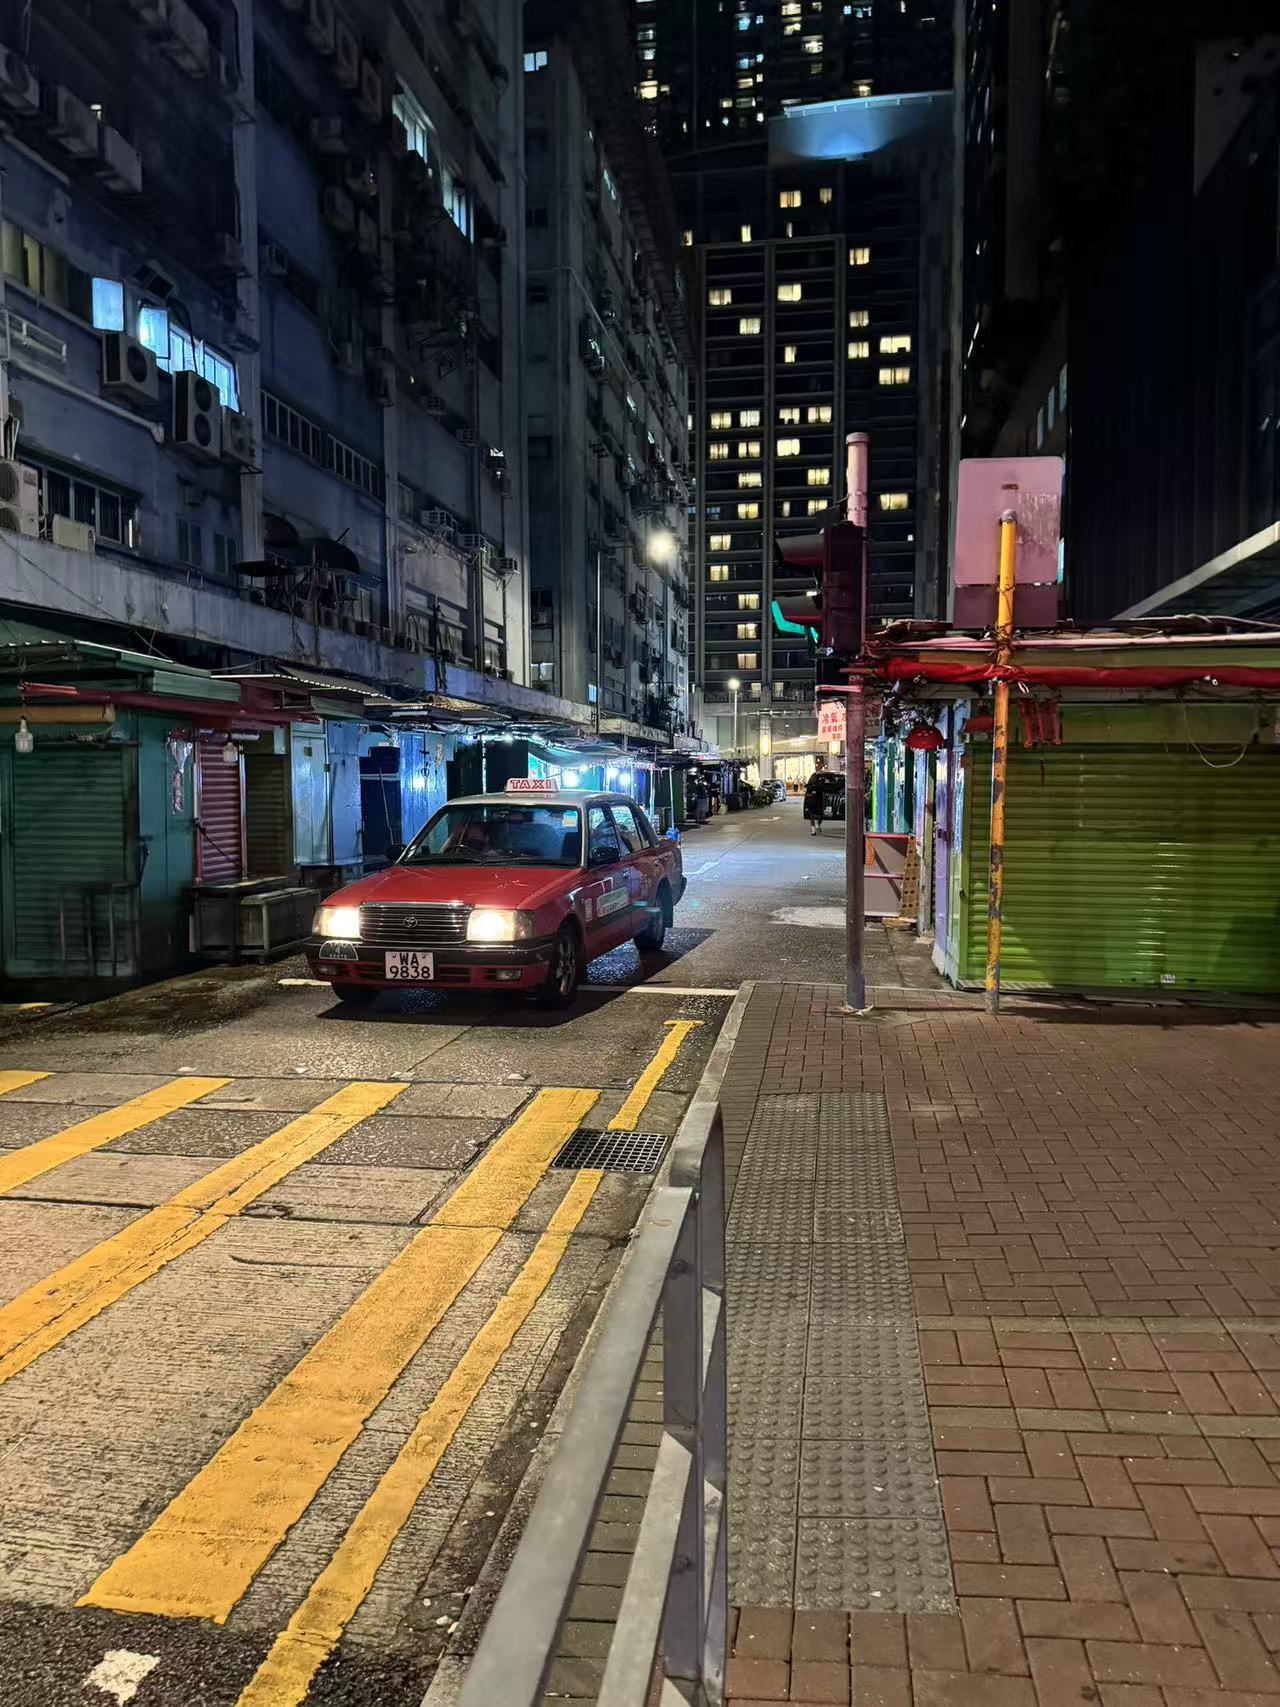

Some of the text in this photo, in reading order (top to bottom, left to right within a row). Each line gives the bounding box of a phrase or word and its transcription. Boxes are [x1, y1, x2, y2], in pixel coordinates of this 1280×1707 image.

[511, 779, 552, 789] TAXI
[399, 952, 420, 966] WA
[389, 965, 431, 979] 9838
